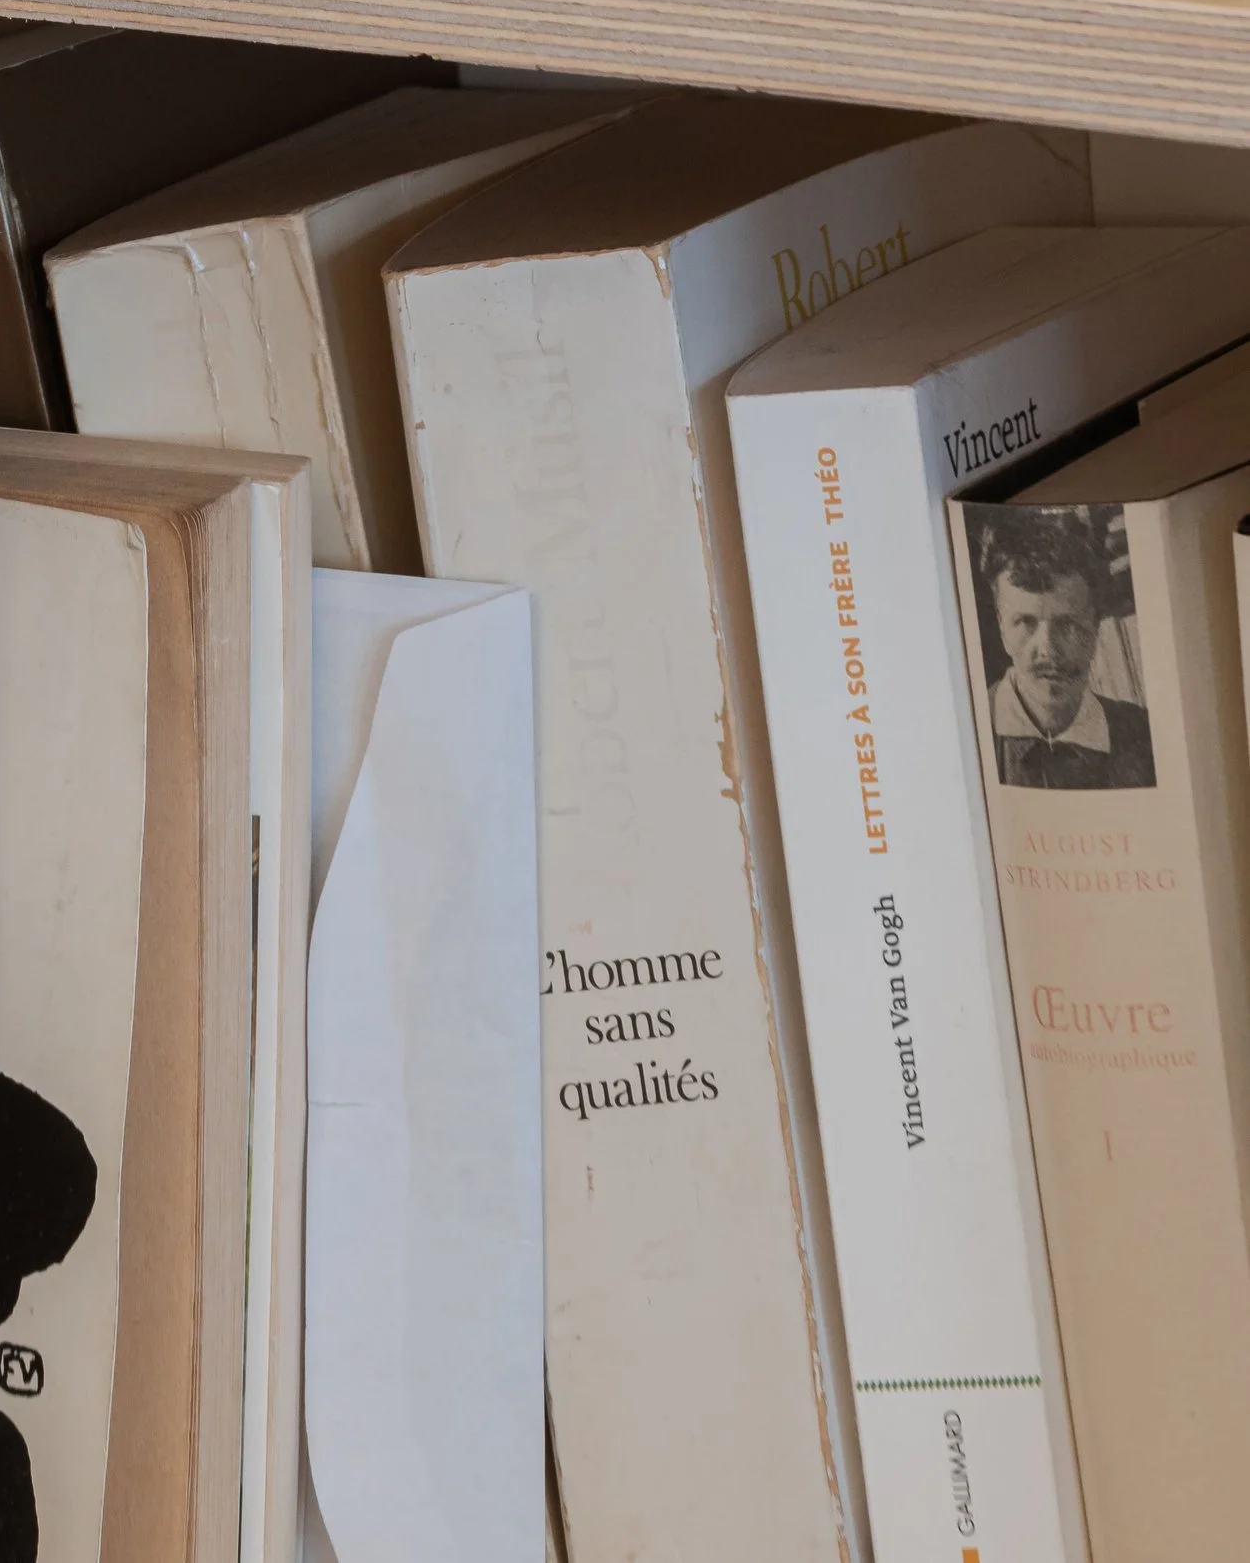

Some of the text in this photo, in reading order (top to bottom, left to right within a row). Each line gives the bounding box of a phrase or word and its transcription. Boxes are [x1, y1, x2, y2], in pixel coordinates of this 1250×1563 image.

[943, 397, 1042, 479] Vincent
[814, 446, 888, 855] LETTRES À SON FRÈRE THÉO
[1024, 831, 1134, 857] AUGUST
[1005, 864, 1178, 893] STRINDBERG
[584, 1007, 676, 1046] sans
[873, 893, 926, 1151] Vincent Van Gogh
[1032, 984, 1174, 1035] Œuvre
[558, 1057, 720, 1122] qualités
[943, 1408, 976, 1538] GALLIMARD
